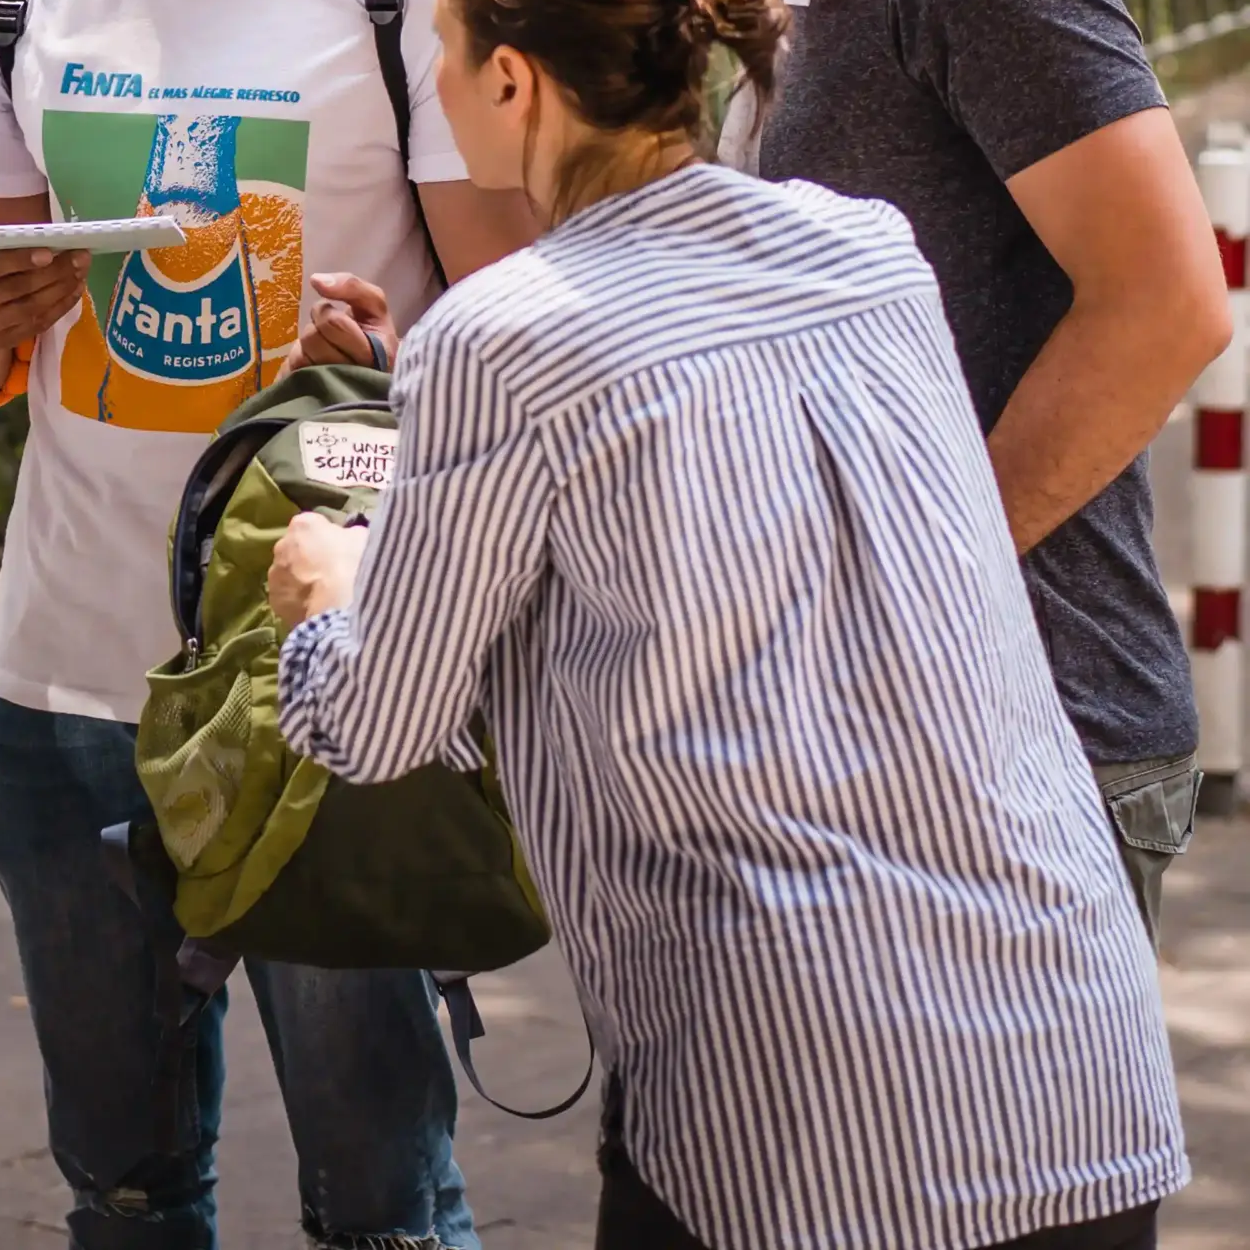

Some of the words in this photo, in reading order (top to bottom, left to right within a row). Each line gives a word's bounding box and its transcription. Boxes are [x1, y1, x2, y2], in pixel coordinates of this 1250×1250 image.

[60, 62, 142, 97] FANTA
[148, 87, 161, 98] EL
[162, 88, 188, 99] MAS
[236, 88, 301, 103] REFRESCO
[116, 276, 242, 345] Fanta
[112, 327, 144, 358] MARCA
[163, 346, 245, 368] REGISTRADA
